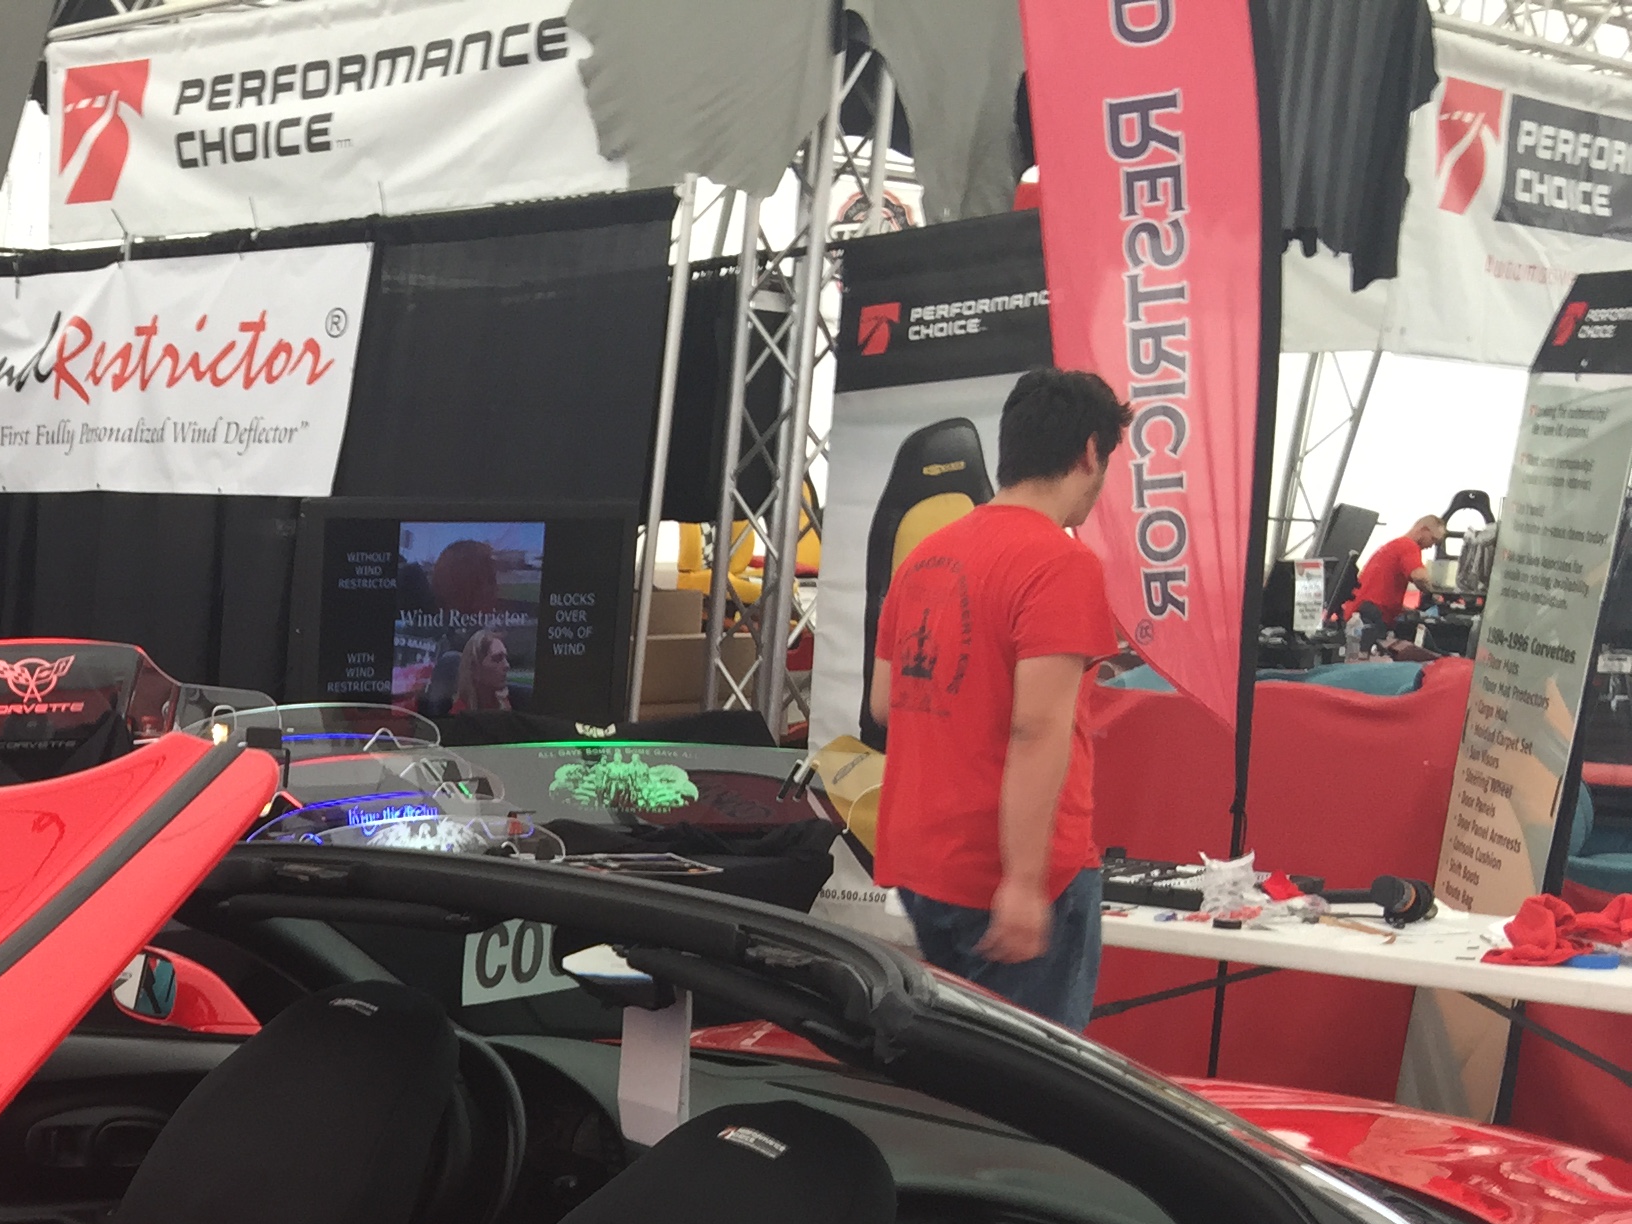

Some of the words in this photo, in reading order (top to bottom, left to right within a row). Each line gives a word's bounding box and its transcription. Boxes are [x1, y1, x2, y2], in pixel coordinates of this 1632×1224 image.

[174, 16, 568, 115] PERFORMANCE
[175, 112, 333, 169] CHOICE
[1515, 169, 1612, 217] CHOICE
[910, 290, 1049, 322] PERFORMANC
[908, 318, 981, 340] CHOICE
[1578, 325, 1617, 338] CHOICE
[0, 426, 30, 447] First
[35, 419, 75, 455] Fully
[173, 420, 217, 444] Wind
[347, 552, 391, 563] WITHOUT
[355, 565, 383, 576] WIND
[338, 578, 397, 589] RESTRICTOR
[549, 593, 595, 606] BLOCKS
[399, 609, 443, 628] Wind
[448, 609, 529, 628] Restrictor
[555, 610, 587, 623] OVER
[548, 626, 573, 640] 50%
[577, 626, 593, 639] OF
[552, 643, 585, 655] WIND
[1531, 639, 1576, 664] Corvettes
[347, 653, 375, 664] WITH
[345, 667, 375, 678] WIND
[327, 681, 391, 693] RESTRICTOR
